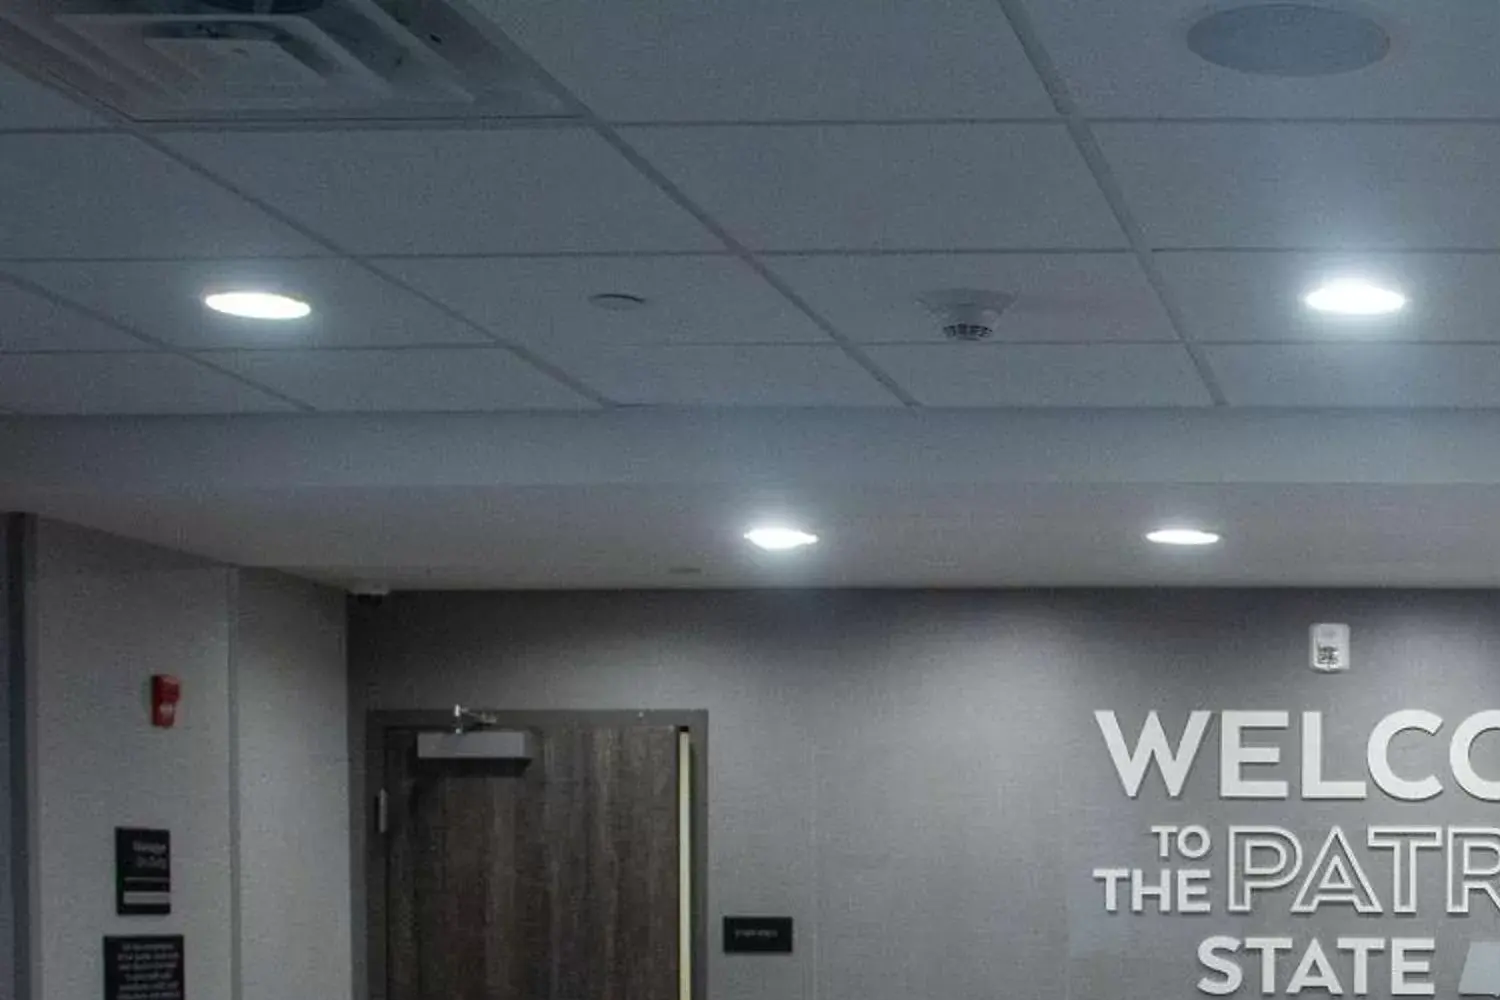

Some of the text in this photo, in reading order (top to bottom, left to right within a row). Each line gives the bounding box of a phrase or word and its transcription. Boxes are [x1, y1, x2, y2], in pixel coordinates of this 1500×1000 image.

[1151, 826, 1211, 858] TO
[1093, 868, 1211, 912] THE
[1197, 936, 1435, 997] STATE
